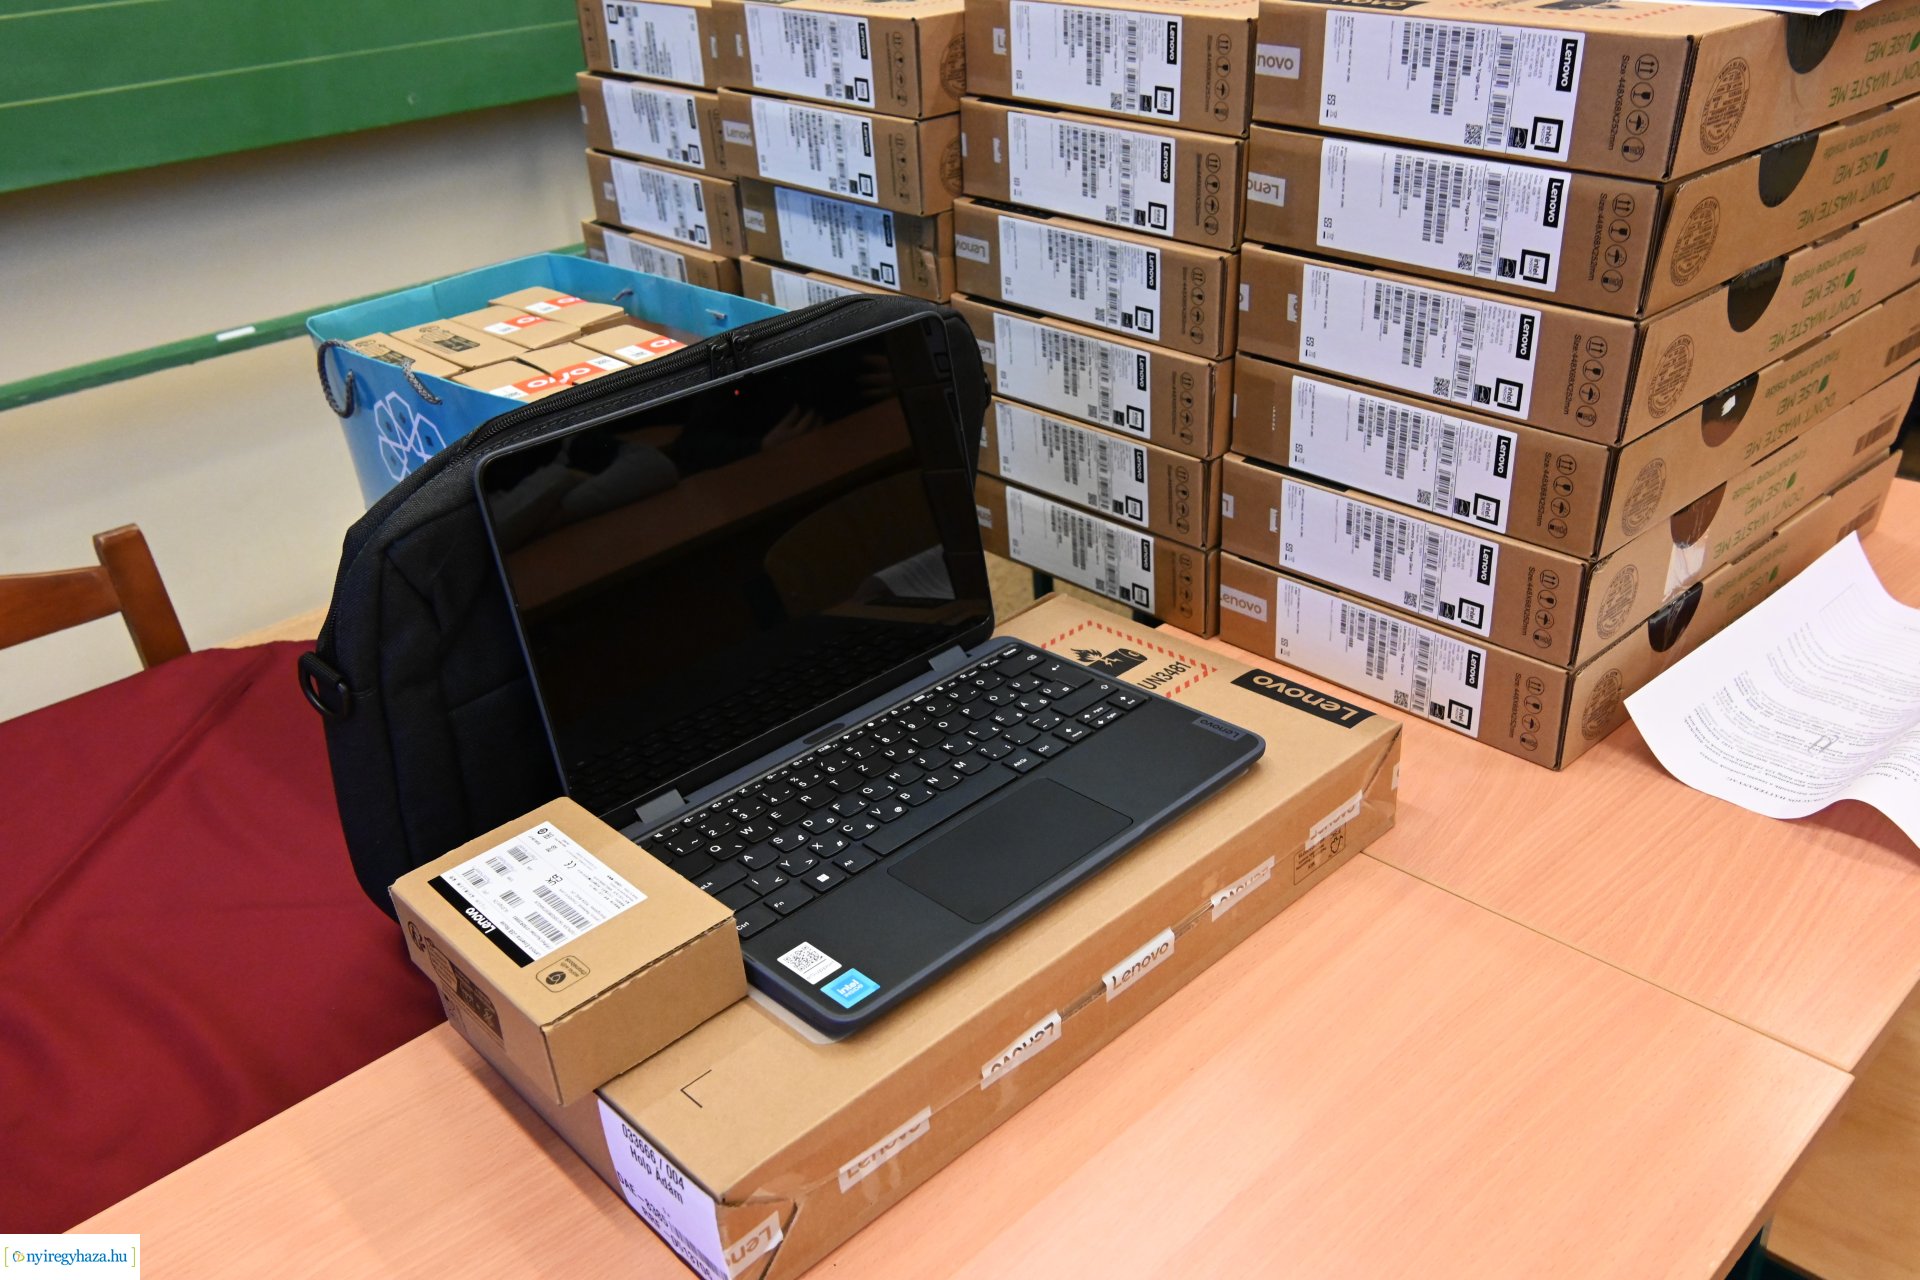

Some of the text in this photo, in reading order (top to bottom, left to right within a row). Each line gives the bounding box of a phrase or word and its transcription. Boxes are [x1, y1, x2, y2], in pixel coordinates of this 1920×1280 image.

[1887, 32, 1911, 57] USE
[1257, 54, 1294, 70] novo
[1560, 43, 1575, 87] Lenovo
[1848, 71, 1890, 101] WASTE
[1544, 126, 1553, 145] intel
[1855, 151, 1879, 176] USE
[1548, 182, 1561, 223] Lenovo
[1817, 190, 1858, 221] WASTE
[1823, 272, 1847, 298] USE
[1520, 318, 1532, 356] Lenovo
[1788, 309, 1828, 342] WASTE
[1797, 379, 1820, 405] USE
[1763, 413, 1802, 448] WASTE
[1497, 440, 1509, 474] Lenovo
[1764, 477, 1787, 503] USE
[1481, 549, 1491, 581] Lenovo
[1221, 593, 1262, 614] enovo
[1137, 661, 1192, 690] UN3481
[1469, 654, 1479, 685] Lenovo
[1252, 675, 1359, 723] Lenovo
[1200, 718, 1240, 739] Lenovo
[954, 761, 967, 769] M
[1013, 758, 1028, 767] AltGr
[927, 776, 939, 784] N
[771, 811, 781, 819] E
[871, 807, 881, 815] V
[740, 826, 753, 836] W
[803, 819, 813, 827] D
[843, 824, 853, 832] C
[709, 845, 721, 853] Q
[773, 836, 784, 844] S
[812, 842, 824, 850] X
[744, 854, 754, 862] A
[781, 860, 791, 868] Y
[844, 859, 854, 867] Alt
[774, 900, 785, 909] Fn
[465, 907, 497, 934] Lenovo
[736, 921, 750, 931] Ctrl
[1112, 942, 1169, 990] Lenovo
[836, 978, 860, 995] intel
[621, 1123, 656, 1165] 033666
[665, 1163, 685, 1190] 004
[629, 1145, 652, 1175] Holp
